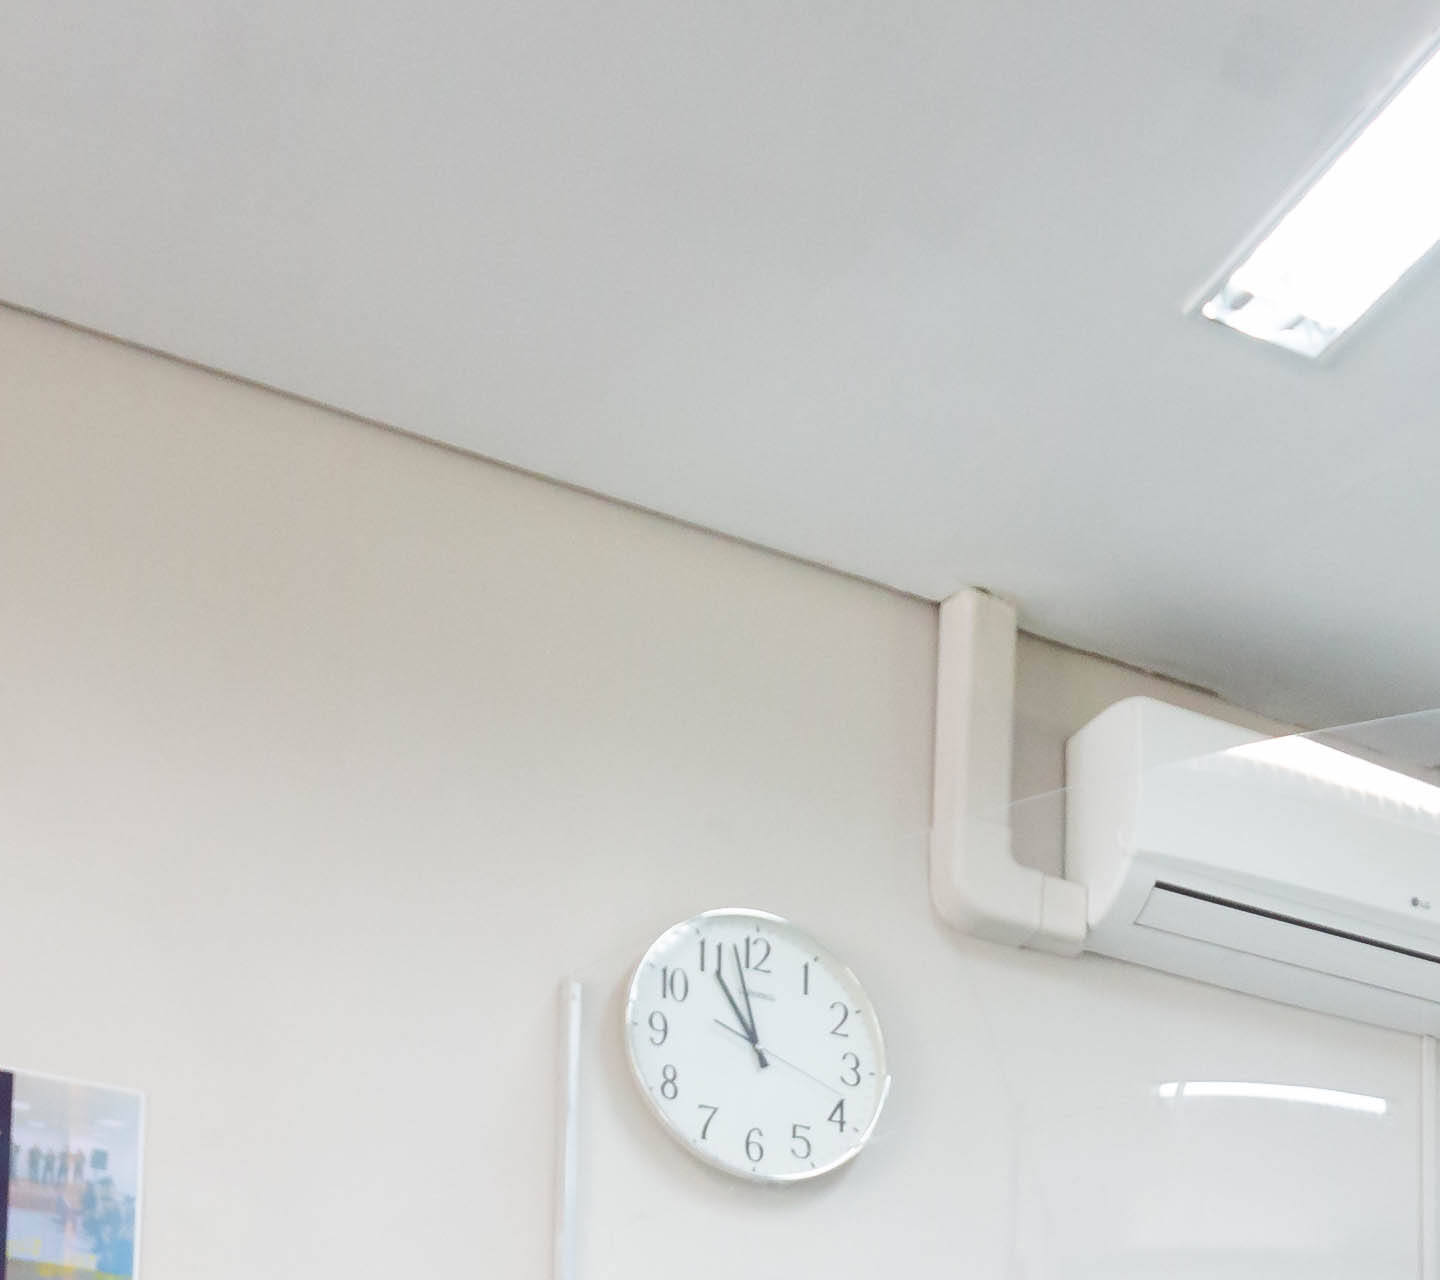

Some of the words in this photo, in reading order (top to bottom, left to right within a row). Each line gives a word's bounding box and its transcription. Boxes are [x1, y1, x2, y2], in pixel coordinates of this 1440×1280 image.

[744, 935, 773, 974] 12
[661, 965, 689, 1002] 10
[801, 961, 810, 996] 1
[648, 1010, 669, 1046] 9
[829, 1001, 849, 1038] 2
[660, 1063, 679, 1101] 8
[839, 1051, 862, 1087] 3
[697, 1104, 719, 1140] 7
[827, 1098, 847, 1133] 4
[745, 1127, 765, 1162] 6
[790, 1123, 812, 1160] 5
